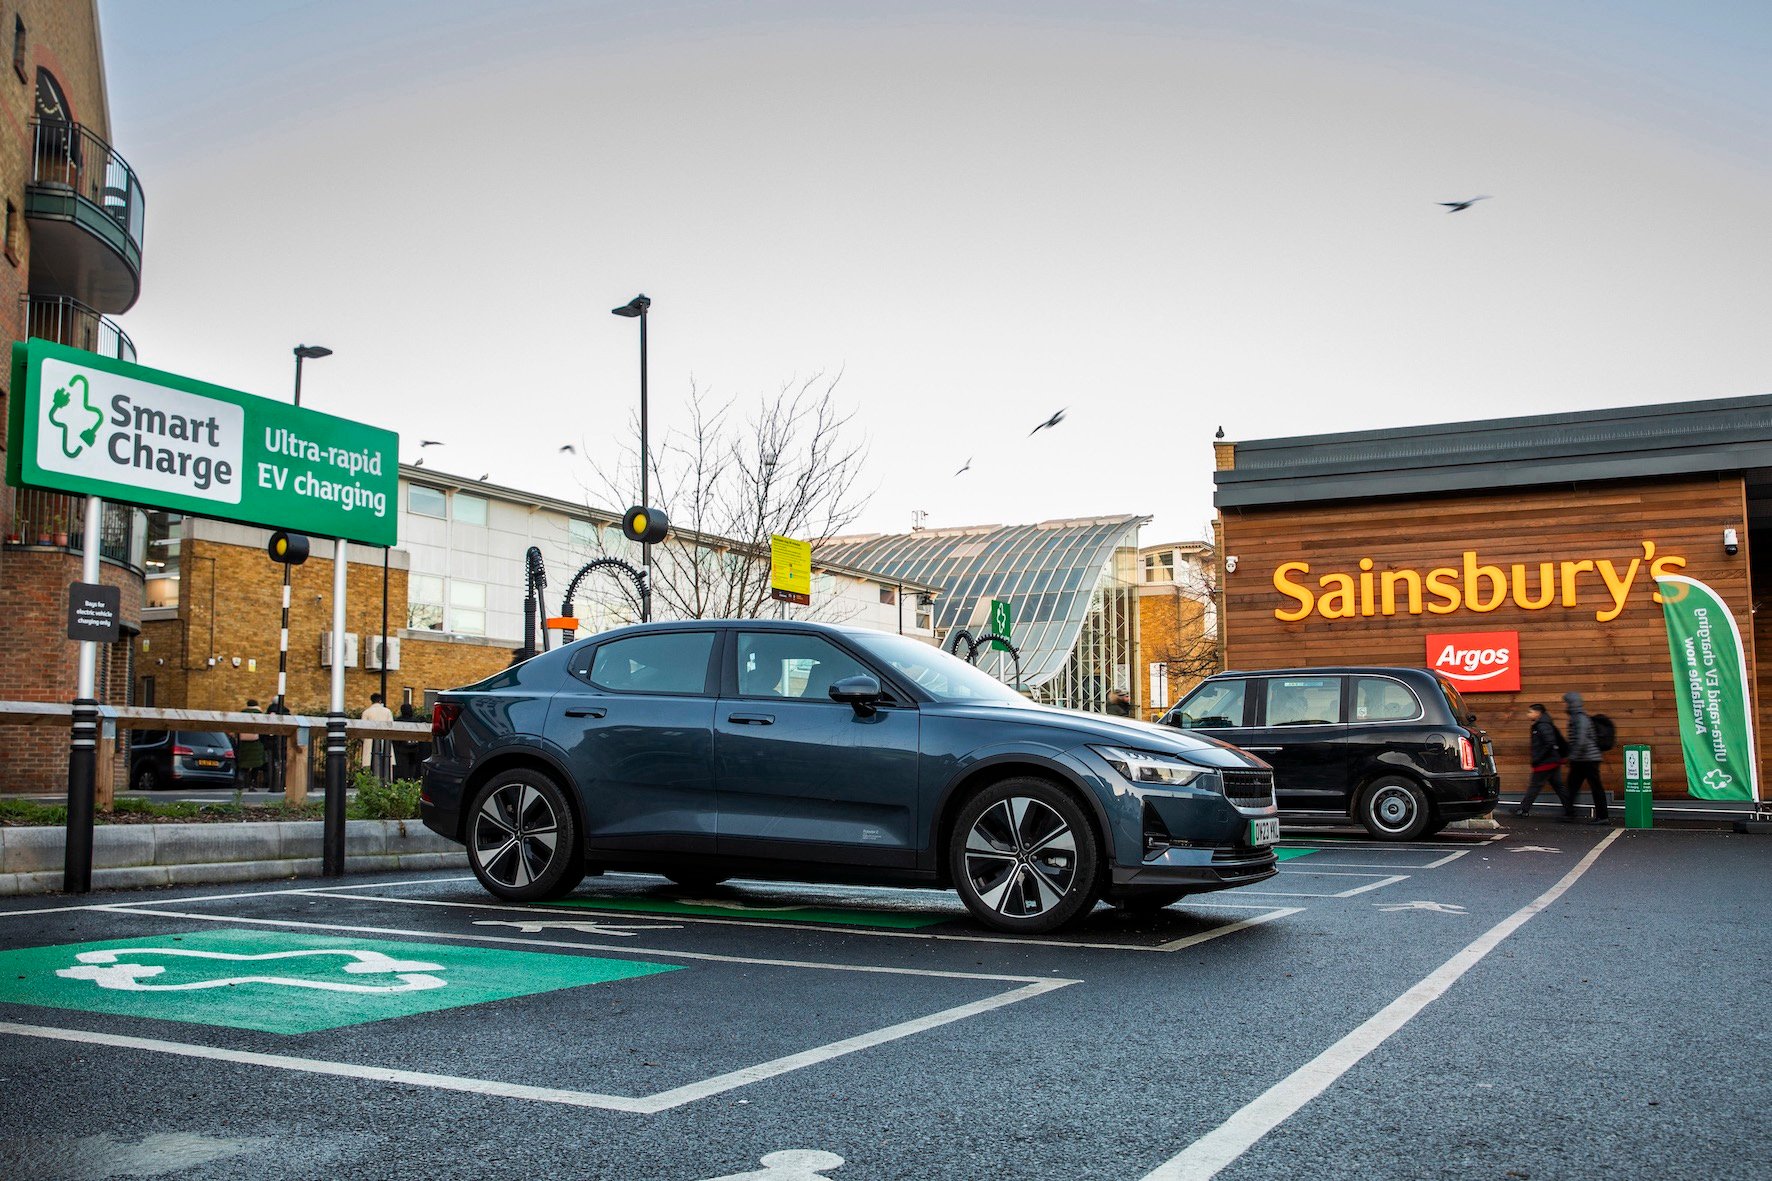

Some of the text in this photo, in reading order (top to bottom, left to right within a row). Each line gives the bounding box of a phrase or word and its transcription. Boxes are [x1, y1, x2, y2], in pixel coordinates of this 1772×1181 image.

[111, 394, 220, 447] Smart
[108, 432, 232, 490] Charge
[265, 427, 382, 477] Ultra-rapid
[258, 462, 386, 518] EV charging
[84, 600, 98, 608] Bays
[1273, 540, 1690, 622] Sainsbury's
[78, 618, 111, 628] charging only
[1435, 644, 1510, 672] Argos
